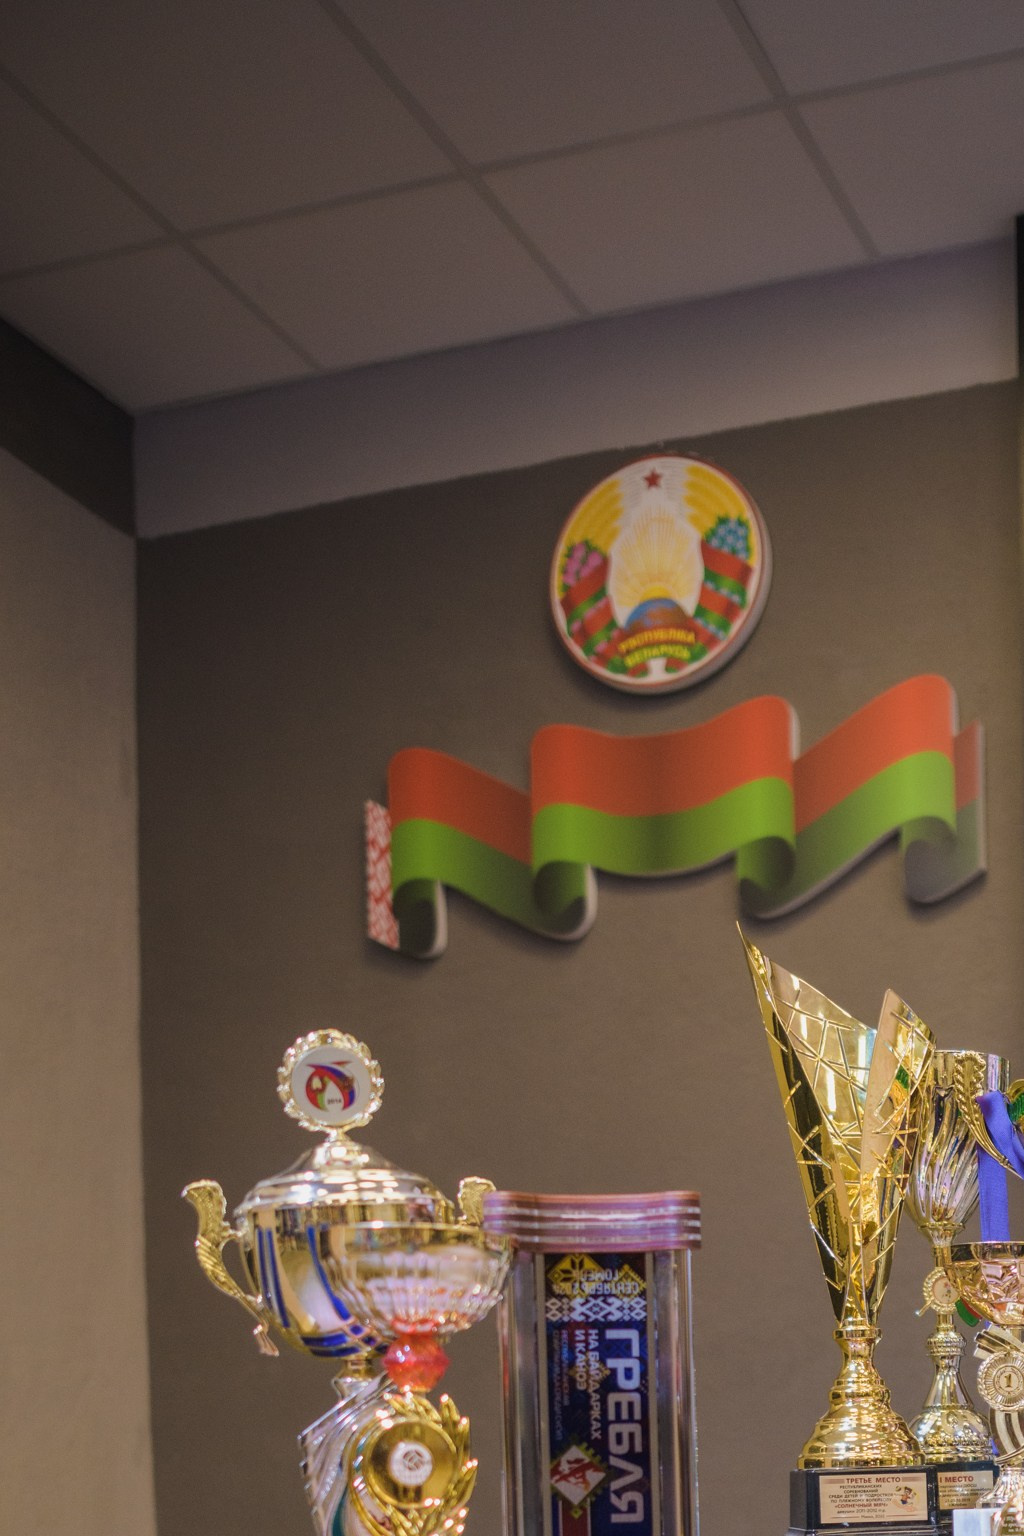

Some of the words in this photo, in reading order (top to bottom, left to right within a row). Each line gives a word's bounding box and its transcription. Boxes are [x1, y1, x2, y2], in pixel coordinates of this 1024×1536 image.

[572, 1269, 619, 1282] ГОМЕЛЬ
[581, 1281, 640, 1295] СЕНТЯБРЬ
[575, 1329, 586, 1341] И
[588, 1329, 600, 1350] НА
[575, 1342, 587, 1391] КАНОЭ
[1004, 1373, 1013, 1388] 1
[587, 1351, 602, 1440] БАЙДАРКАХ
[605, 1328, 645, 1524] ГРЕБЛЯ
[845, 1477, 873, 1485] ТРЕТЬЕ
[875, 1476, 901, 1484] МЕСТО
[945, 1475, 974, 1483] МЕСТО
